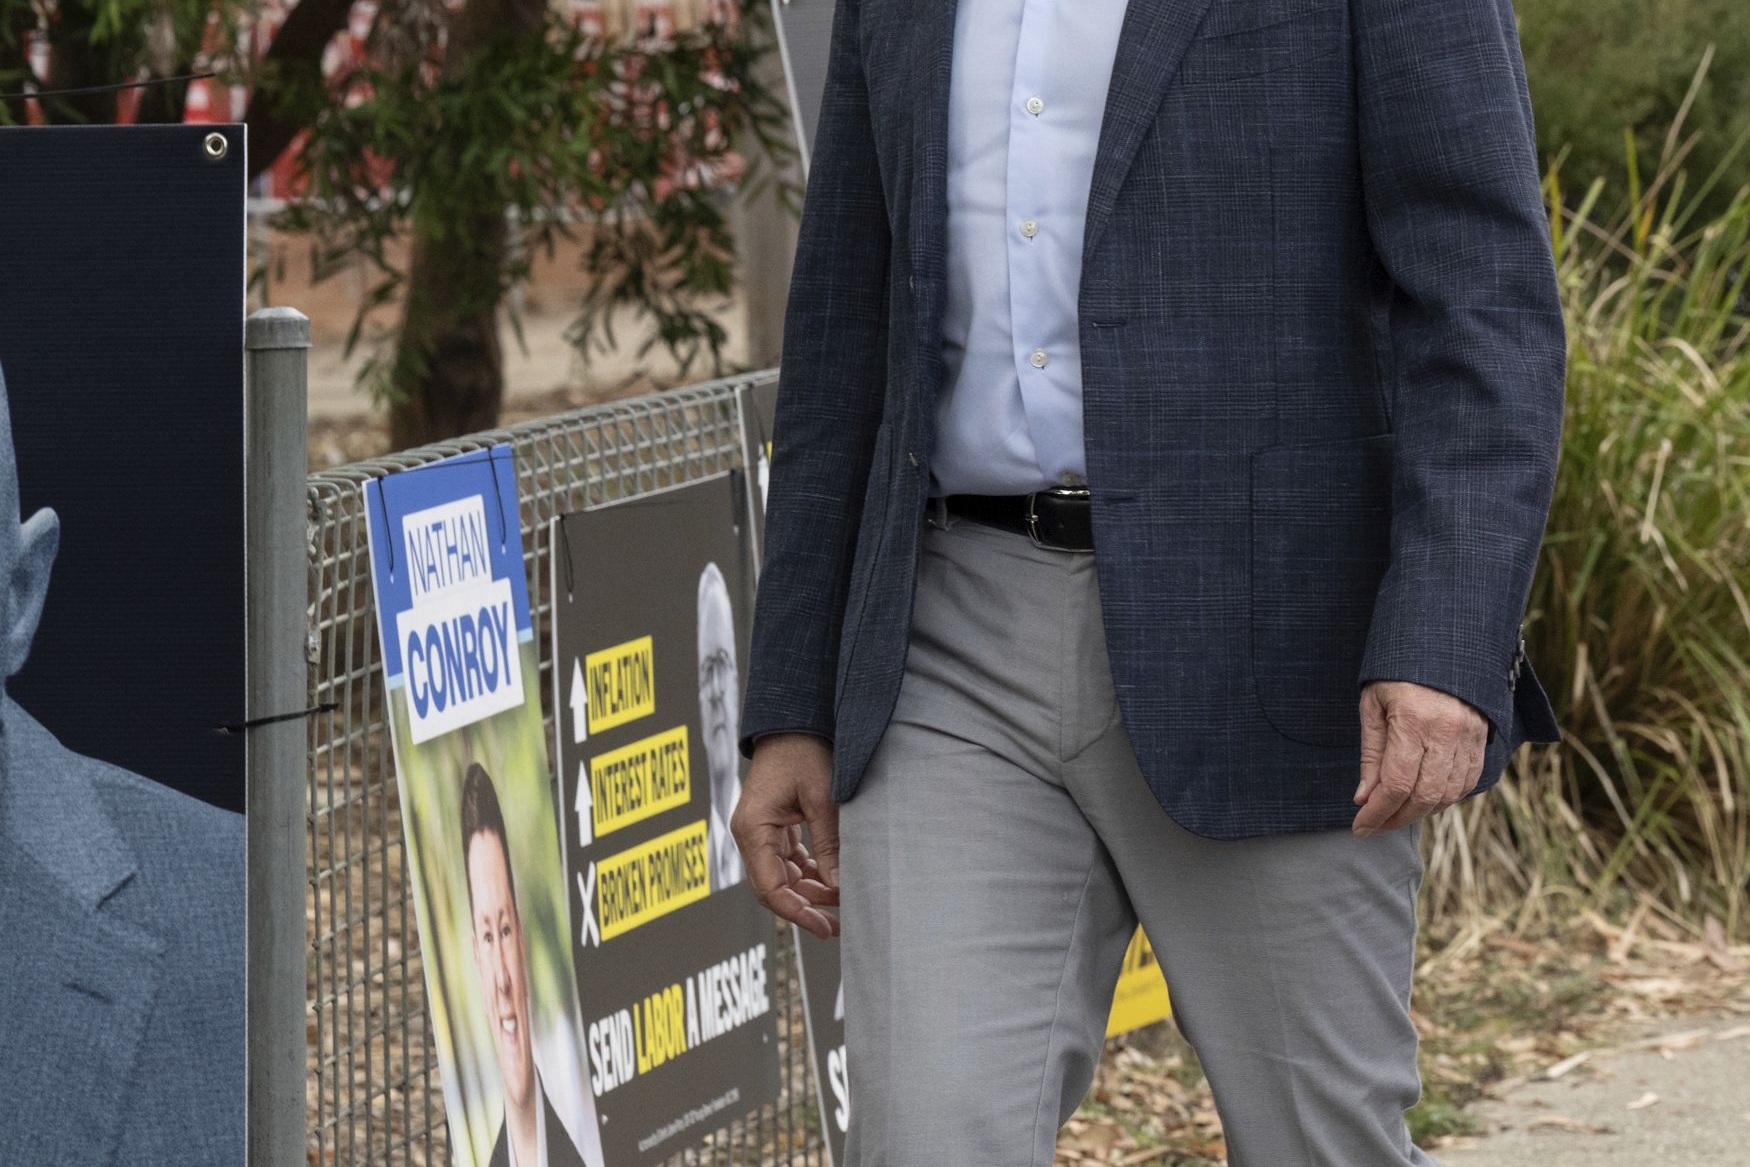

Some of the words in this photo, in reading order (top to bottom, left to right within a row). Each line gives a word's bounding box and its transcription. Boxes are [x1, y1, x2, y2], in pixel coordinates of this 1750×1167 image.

[408, 510, 487, 596] NATHAN
[407, 600, 511, 720] CONROY
[589, 648, 651, 721] INFLATION
[595, 752, 648, 824] INTEREST
[650, 739, 686, 803] RATES
[601, 856, 649, 927] BROKEN
[648, 834, 706, 907] PROMISES
[589, 1008, 635, 1098] SEND
[633, 983, 687, 1075] LABOR
[686, 976, 700, 1050] A
[698, 943, 770, 1043] MESSAGE
